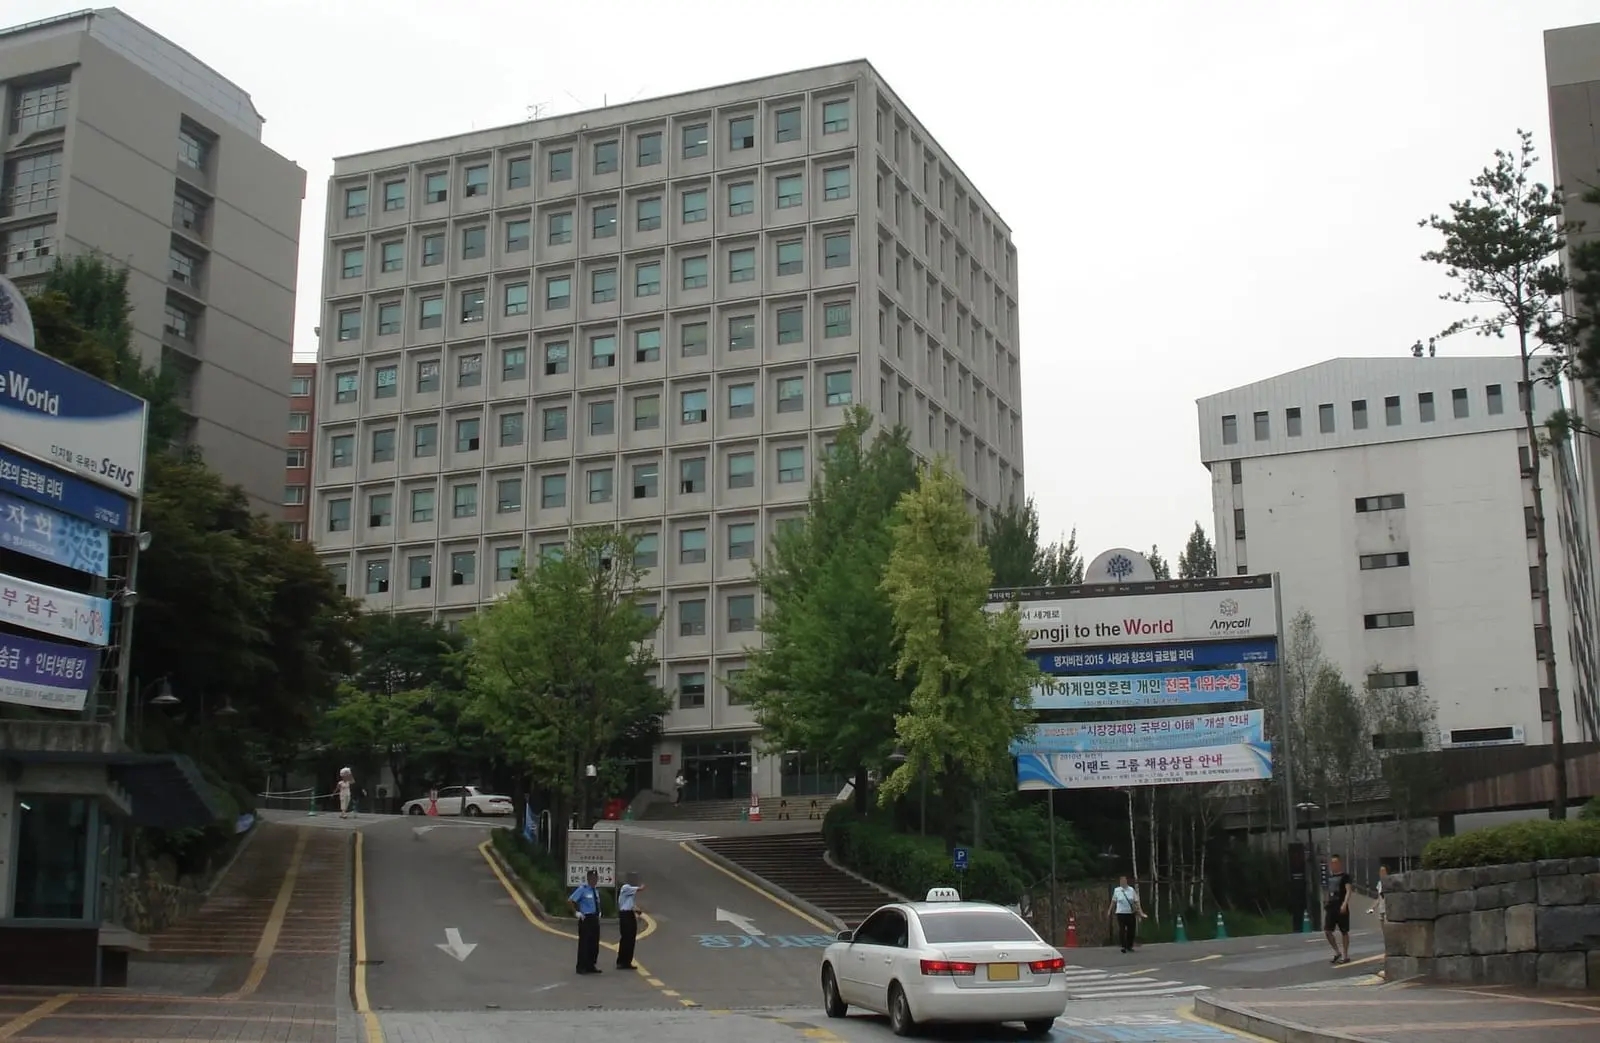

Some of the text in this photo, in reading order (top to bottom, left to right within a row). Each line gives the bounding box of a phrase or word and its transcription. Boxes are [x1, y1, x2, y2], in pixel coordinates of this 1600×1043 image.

[9, 370, 59, 416] World
[100, 457, 134, 487] SENS
[46, 478, 64, 501] 리더
[1074, 624, 1090, 639] to
[1095, 622, 1121, 637] the
[1123, 619, 1174, 636] World
[1209, 617, 1251, 631] Anycall
[1084, 653, 1104, 666] 2015
[1178, 648, 1195, 661] 리더
[1136, 679, 1161, 694] 개인
[1165, 677, 1191, 693] 전국
[1228, 714, 1249, 727] 안내
[1115, 758, 1140, 773] 그룹
[1144, 755, 1194, 772] 채용상담
[1198, 753, 1223, 769] 안내
